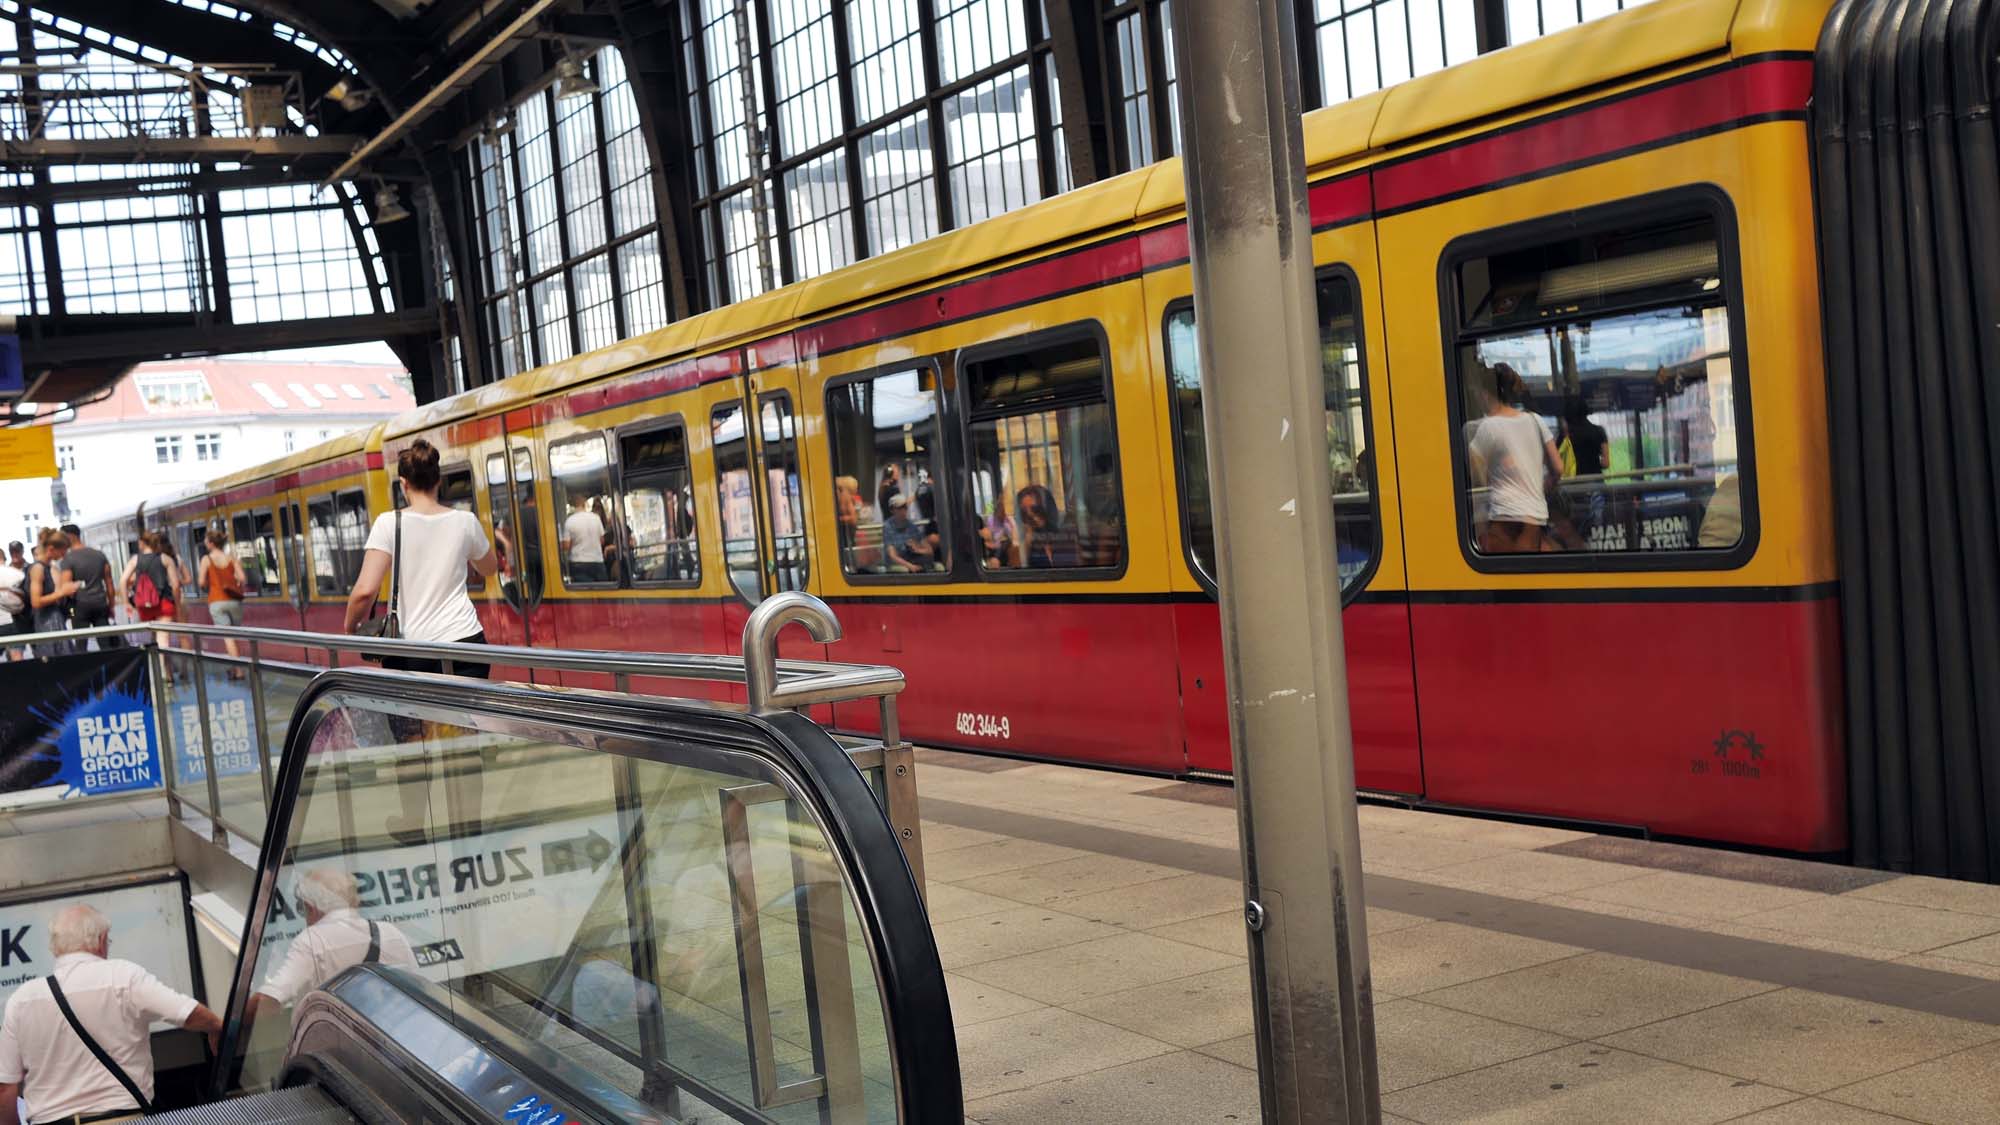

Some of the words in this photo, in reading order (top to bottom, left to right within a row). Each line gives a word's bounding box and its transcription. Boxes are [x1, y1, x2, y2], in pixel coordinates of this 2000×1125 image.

[77, 711, 145, 737] BLUE
[956, 712, 976, 736] 482
[977, 713, 1010, 739] 344-9
[80, 730, 148, 757] MAN
[82, 752, 149, 773] GROUP
[84, 766, 151, 789] BERLIN
[1, 925, 32, 967] K
